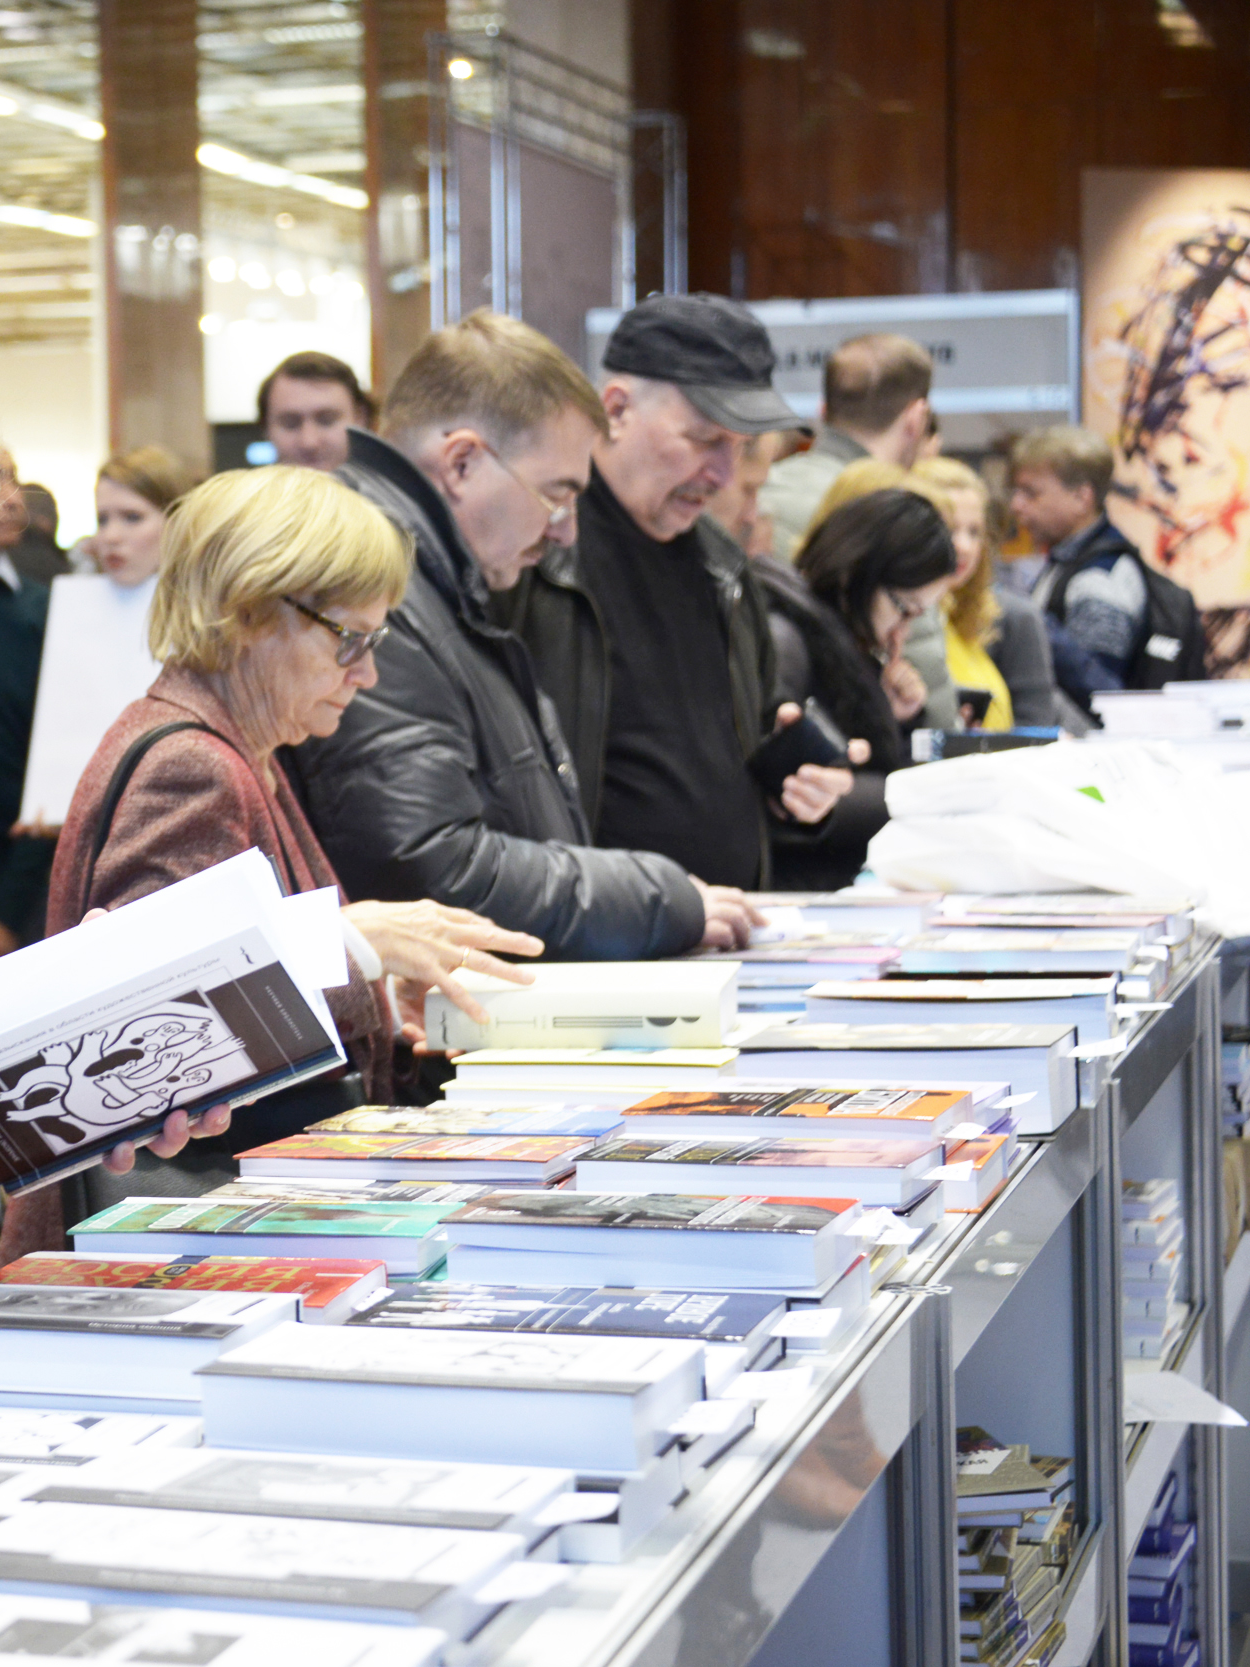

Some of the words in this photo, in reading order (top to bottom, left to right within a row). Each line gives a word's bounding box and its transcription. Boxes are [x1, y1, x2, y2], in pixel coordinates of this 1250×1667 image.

[55, 1006, 96, 1030] области
[97, 975, 175, 1012] художественной
[176, 957, 220, 979] культуры
[19, 1259, 310, 1279] РОССИЯ
